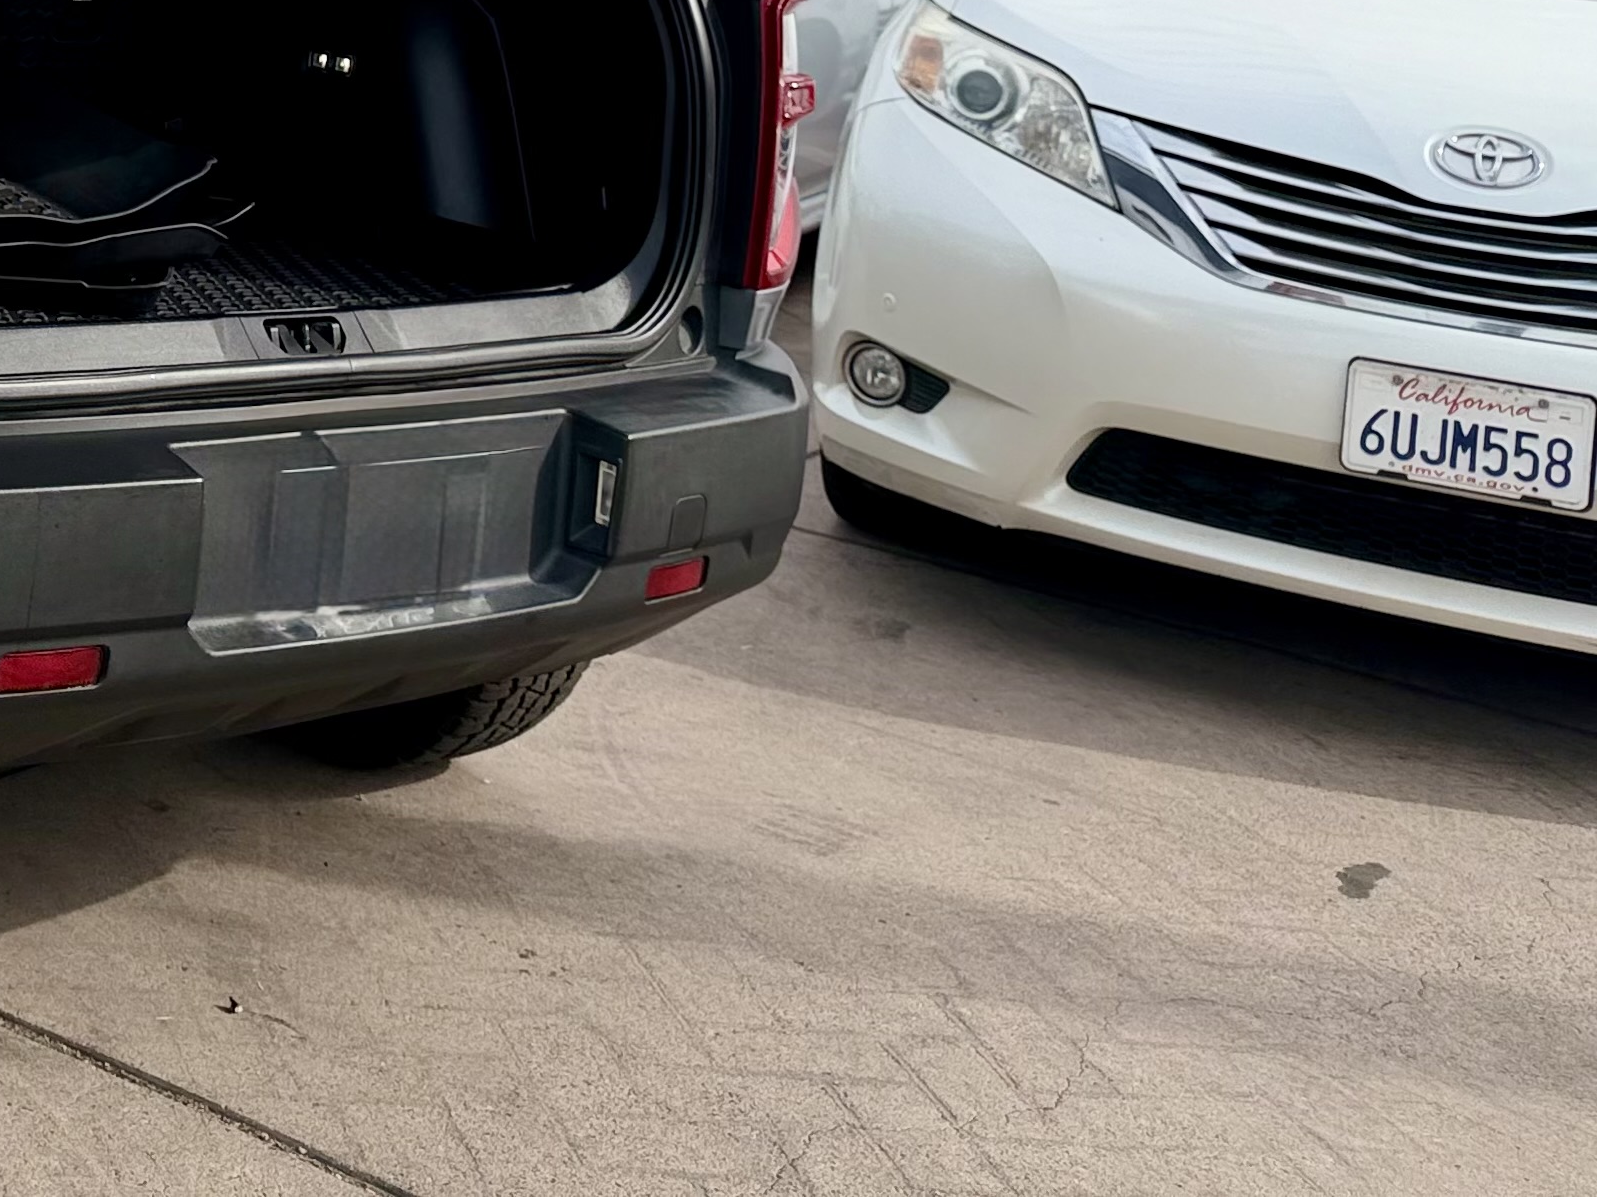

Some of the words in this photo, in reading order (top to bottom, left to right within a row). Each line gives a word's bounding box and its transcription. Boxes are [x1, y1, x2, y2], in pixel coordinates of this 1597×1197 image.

[1398, 377, 1548, 423] California
[1360, 408, 1573, 488] 6UJM558
[1402, 464, 1525, 493] dmv.ca.gov
